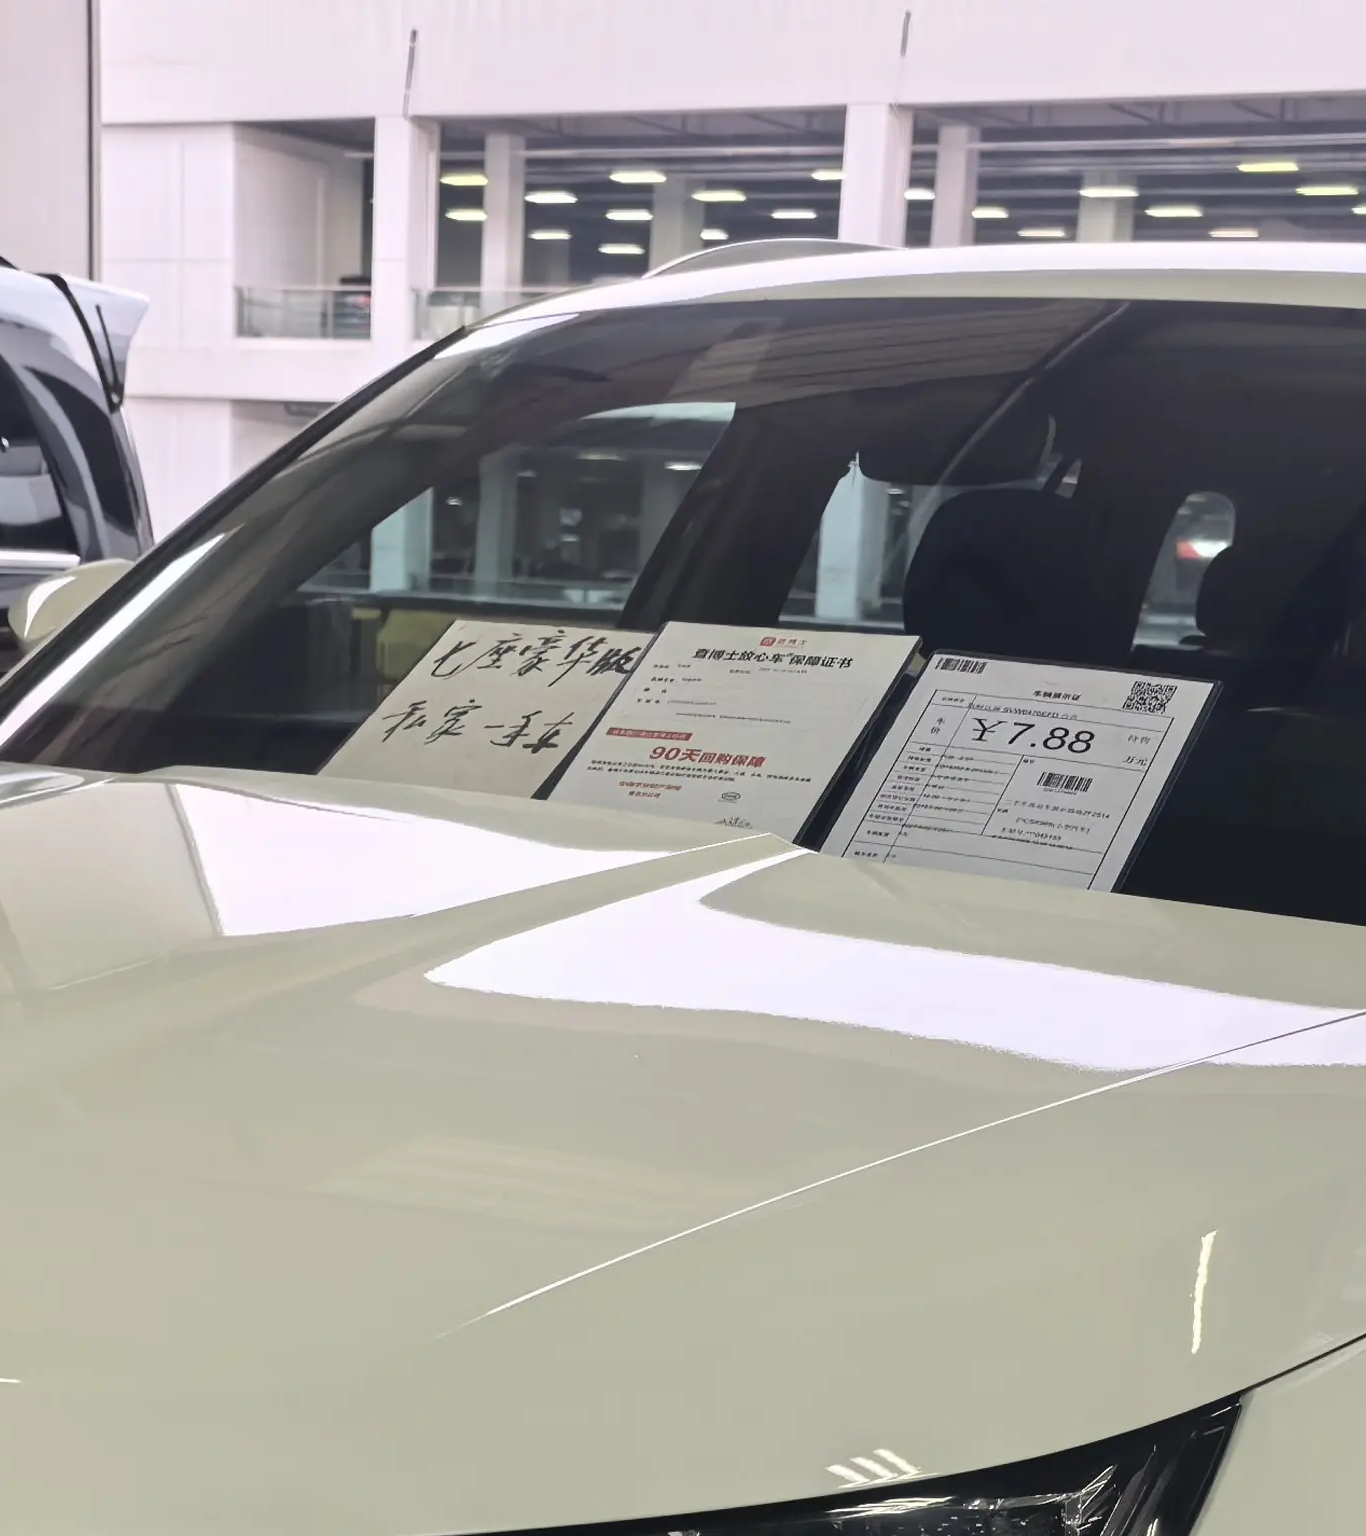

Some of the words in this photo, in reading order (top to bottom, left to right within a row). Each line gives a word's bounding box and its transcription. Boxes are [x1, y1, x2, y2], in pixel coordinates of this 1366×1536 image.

[972, 717, 1095, 754] ¥7.88
[649, 746, 767, 768] 90天回购保障
